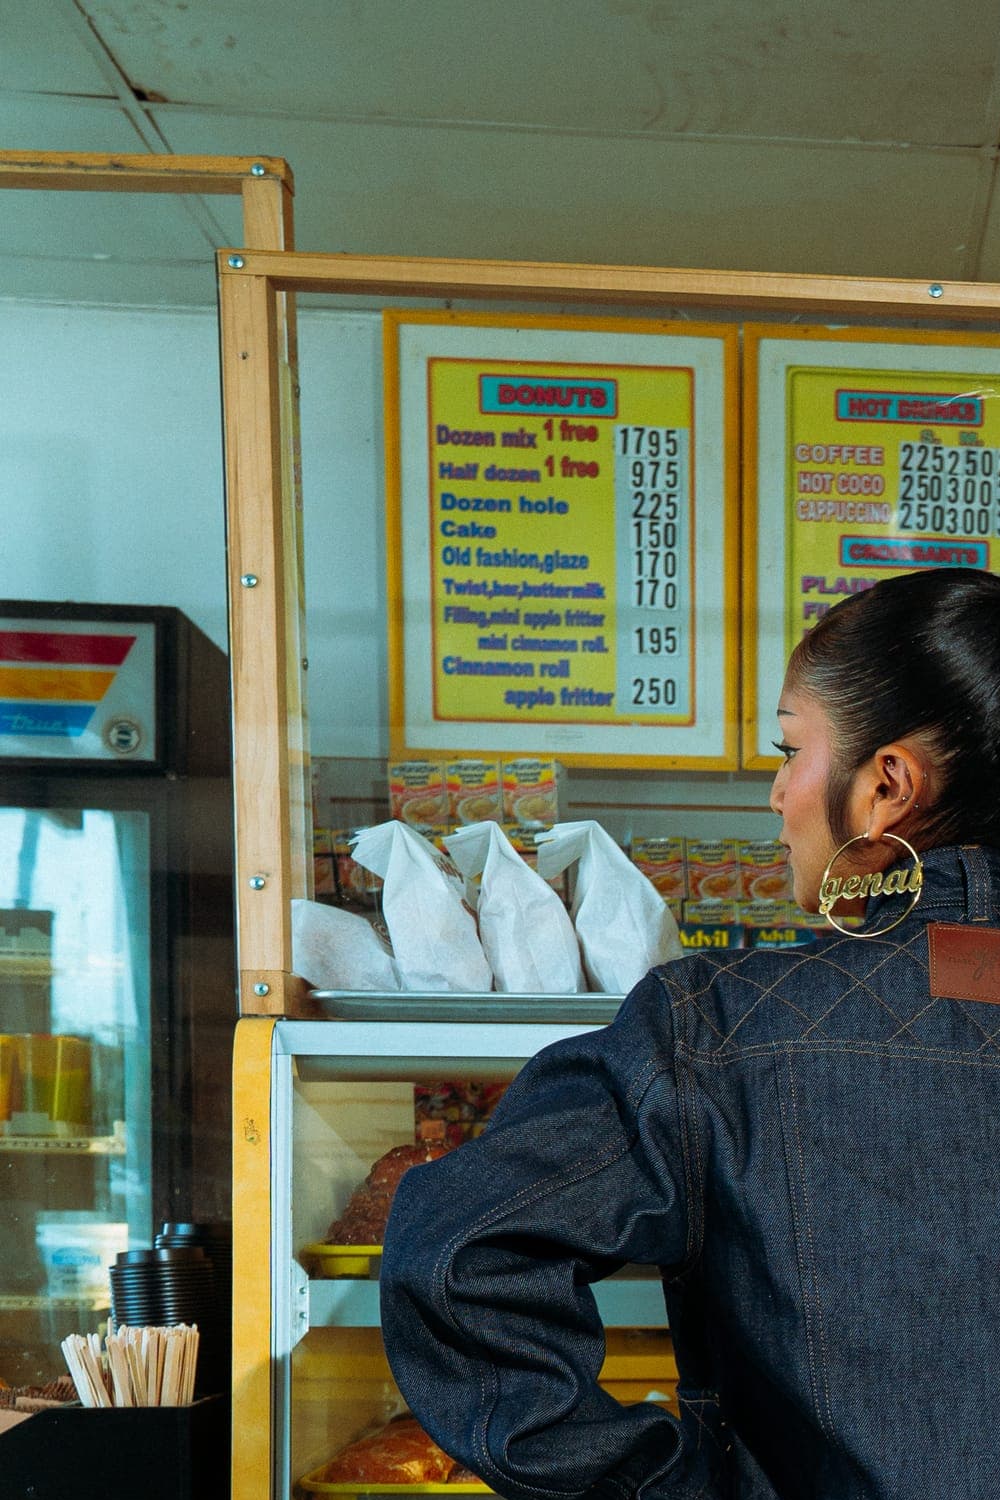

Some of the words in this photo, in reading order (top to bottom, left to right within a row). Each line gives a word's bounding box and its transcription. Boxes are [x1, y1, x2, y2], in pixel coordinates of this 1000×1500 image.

[498, 384, 607, 407] DONUTS
[848, 398, 890, 417] HOT
[898, 400, 975, 421] DRINKS
[437, 425, 495, 447] Dozen
[502, 429, 537, 448] mix
[544, 420, 553, 441] 1
[560, 420, 599, 442] free
[620, 428, 678, 457] 1795
[439, 462, 479, 480] Half
[485, 465, 541, 482] dozen
[544, 456, 554, 477] 1
[560, 457, 599, 478] free
[632, 461, 678, 488] 975
[795, 444, 884, 466] COFFEE
[901, 444, 944, 473] 225
[948, 450, 992, 477] 250
[798, 472, 833, 494] HOT
[837, 475, 884, 496] COCO
[901, 475, 943, 502] 250
[947, 477, 992, 506] 300
[441, 493, 511, 512] Dozen
[519, 496, 569, 514] hole
[632, 492, 678, 520] 225
[900, 503, 944, 532] 250
[946, 508, 989, 534] 300
[440, 521, 497, 539] Cake
[634, 522, 676, 549] 150
[442, 546, 470, 565] Old
[635, 551, 676, 578] 170
[849, 544, 978, 565] CROISSANTS
[635, 580, 676, 609] 170
[524, 611, 561, 629] apple
[565, 611, 605, 626] fritter
[478, 635, 507, 650] mini
[511, 635, 577, 652] cinnamon
[635, 627, 677, 654] 195
[443, 656, 534, 676] Cinnamon
[540, 660, 570, 678] roll
[505, 688, 555, 708] apple
[560, 687, 615, 706] fritter
[632, 679, 676, 705] 250
[680, 930, 729, 948] Advil
[758, 930, 796, 942] Advil
